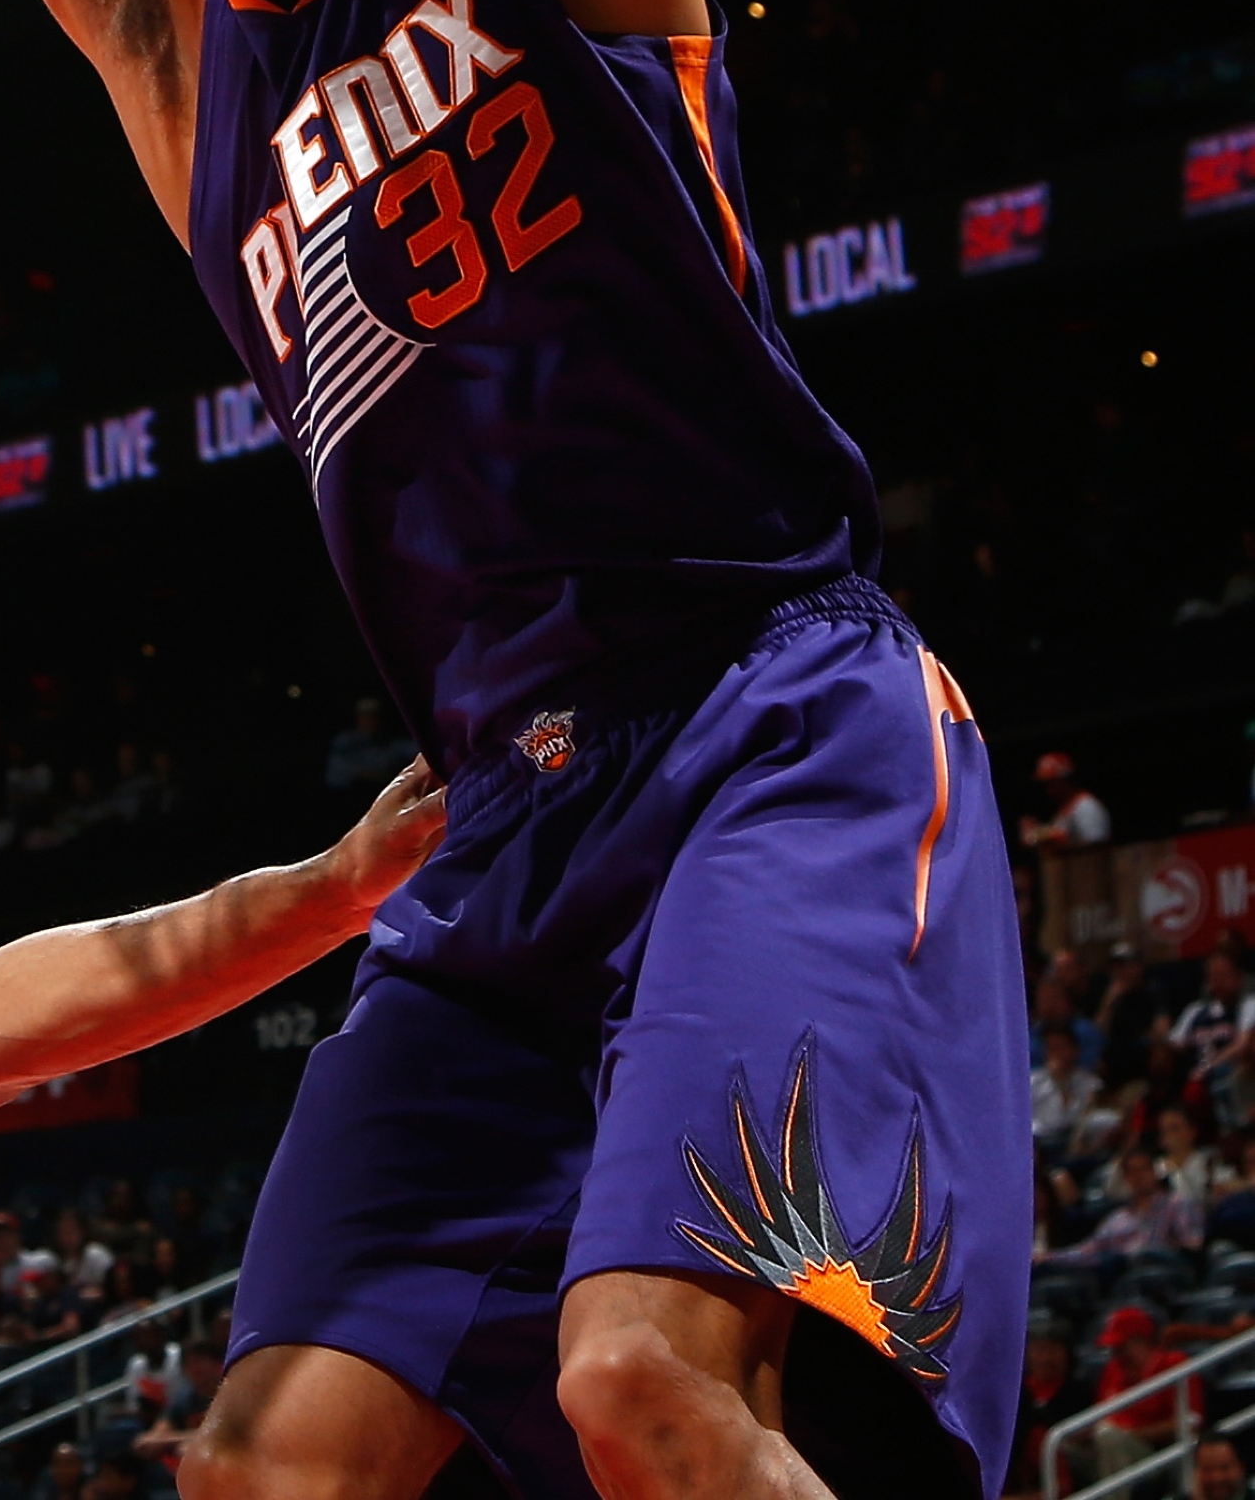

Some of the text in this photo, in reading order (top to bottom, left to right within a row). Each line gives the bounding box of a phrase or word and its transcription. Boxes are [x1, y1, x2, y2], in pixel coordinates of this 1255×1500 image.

[374, 81, 583, 329] 32
[782, 215, 919, 319] LOCAL
[82, 404, 160, 492] LIVE
[194, 377, 285, 464] LOC
[535, 736, 569, 764] PHX
[253, 1002, 318, 1050] 102
